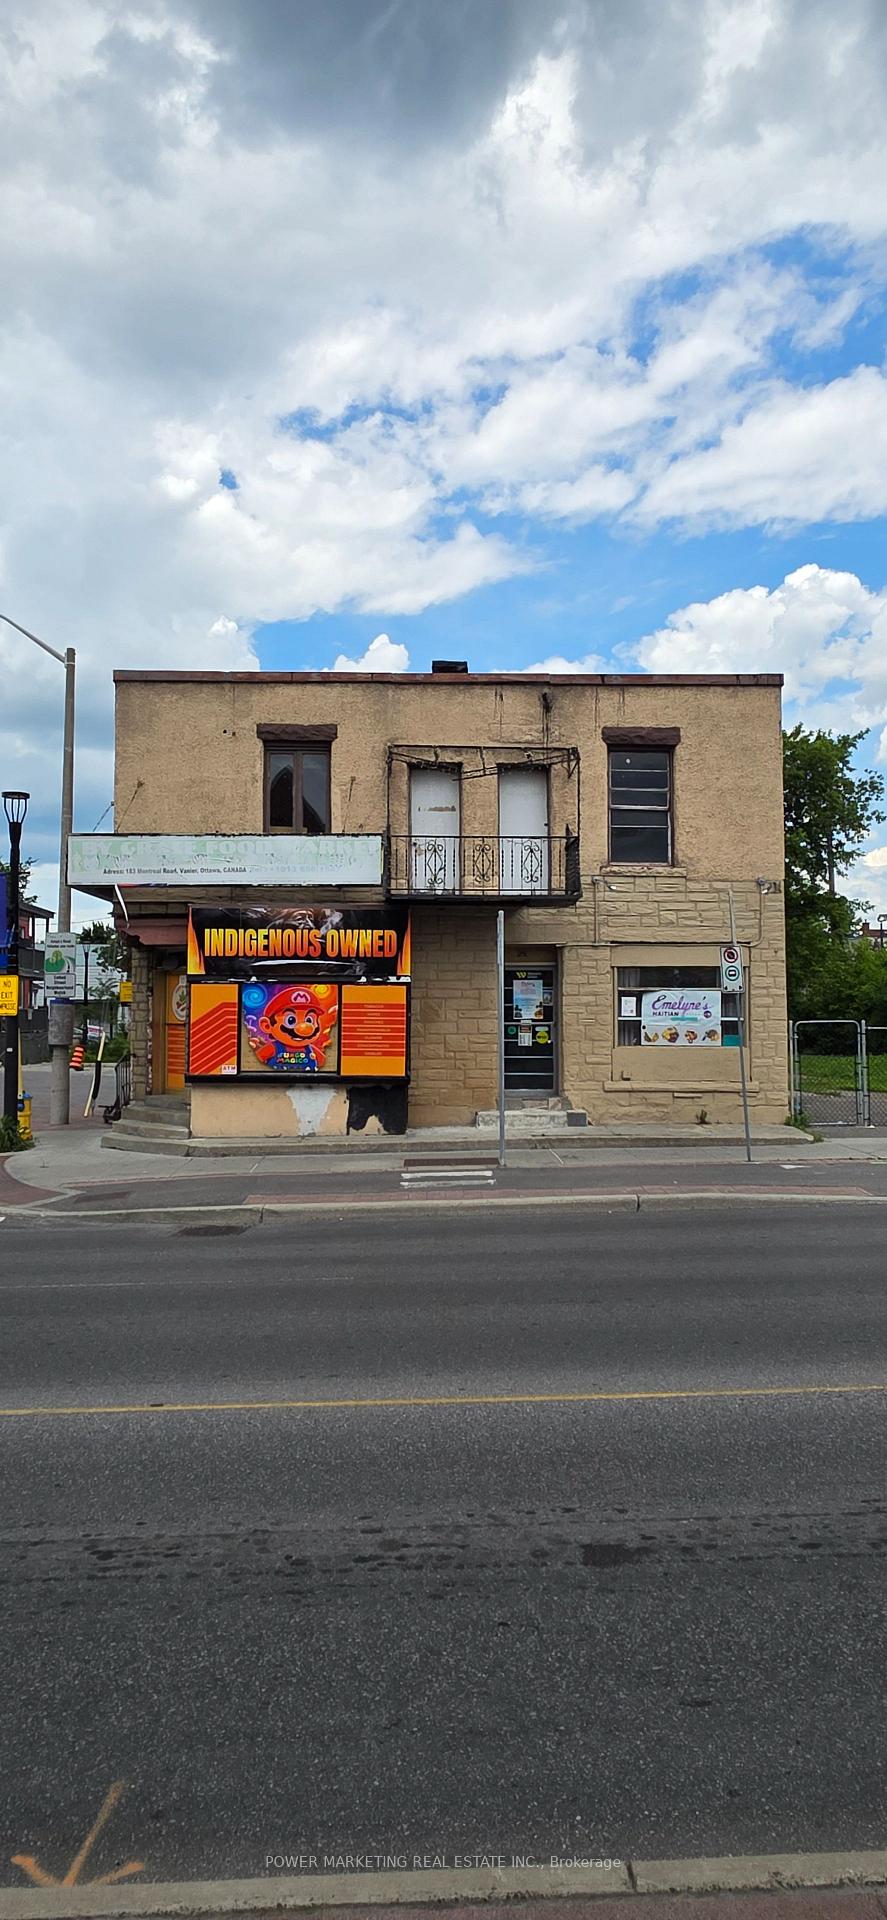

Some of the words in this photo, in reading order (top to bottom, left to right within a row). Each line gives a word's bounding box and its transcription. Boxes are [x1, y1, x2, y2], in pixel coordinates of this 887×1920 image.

[204, 928, 321, 958] INDIGENOUS
[326, 929, 398, 958] OWNED
[1, 991, 13, 999] EXIT
